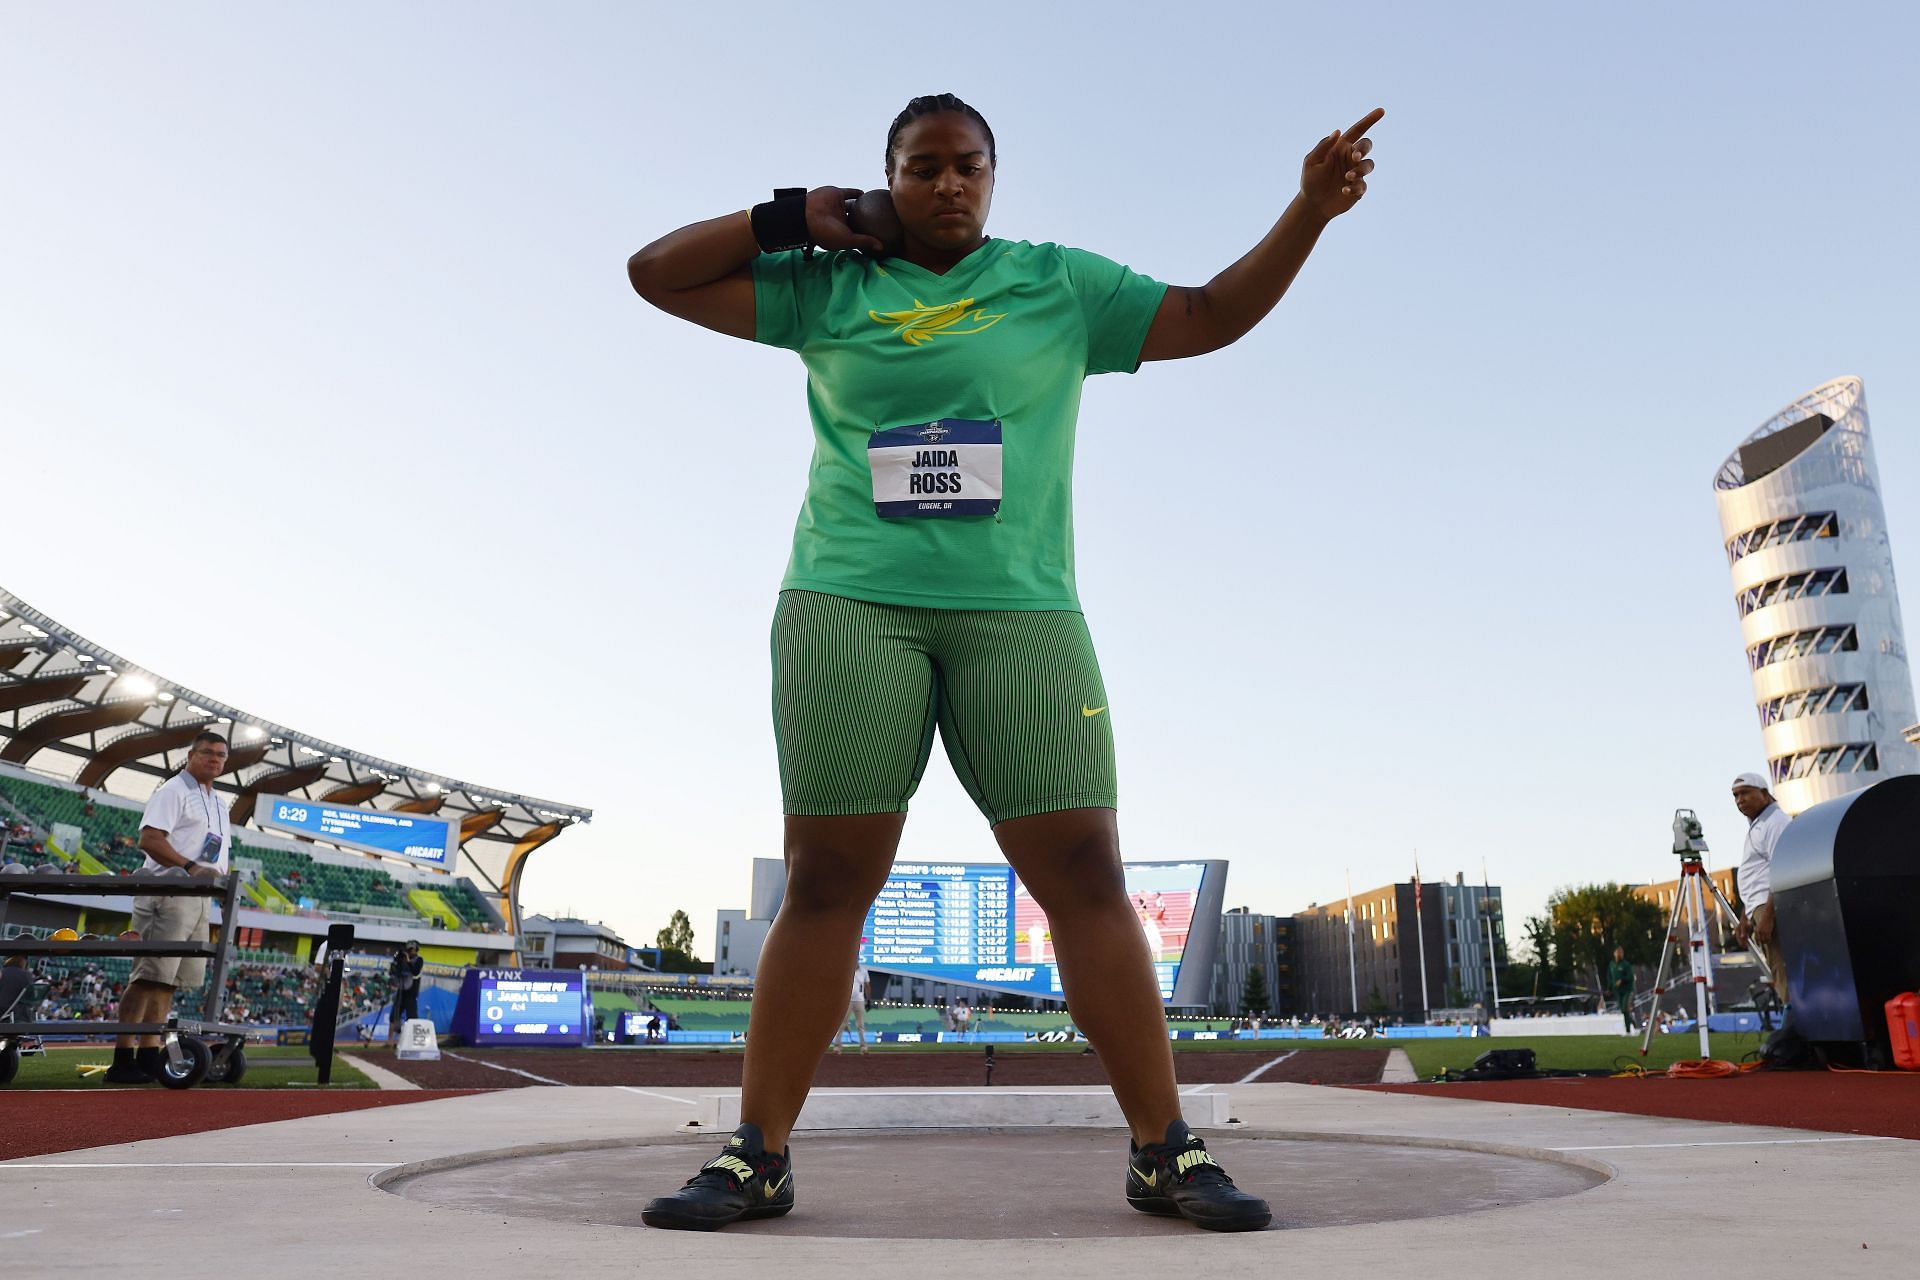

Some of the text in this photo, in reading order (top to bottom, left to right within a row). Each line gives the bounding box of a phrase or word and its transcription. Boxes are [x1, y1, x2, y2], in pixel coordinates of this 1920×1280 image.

[912, 450, 959, 468] JAIDA
[910, 472, 962, 495] ROSS
[918, 502, 942, 510] EUGENE,
[278, 805, 308, 823] 8:29
[404, 845, 445, 860] #NCAATF
[890, 864, 929, 875] OMEN'S
[489, 970, 522, 981] LYNX
[976, 967, 1036, 982] #NCAATF
[486, 991, 493, 1001] 1
[413, 1035, 427, 1046] 52
[704, 1154, 754, 1183] NIKE
[1176, 1149, 1218, 1175] NIKE
